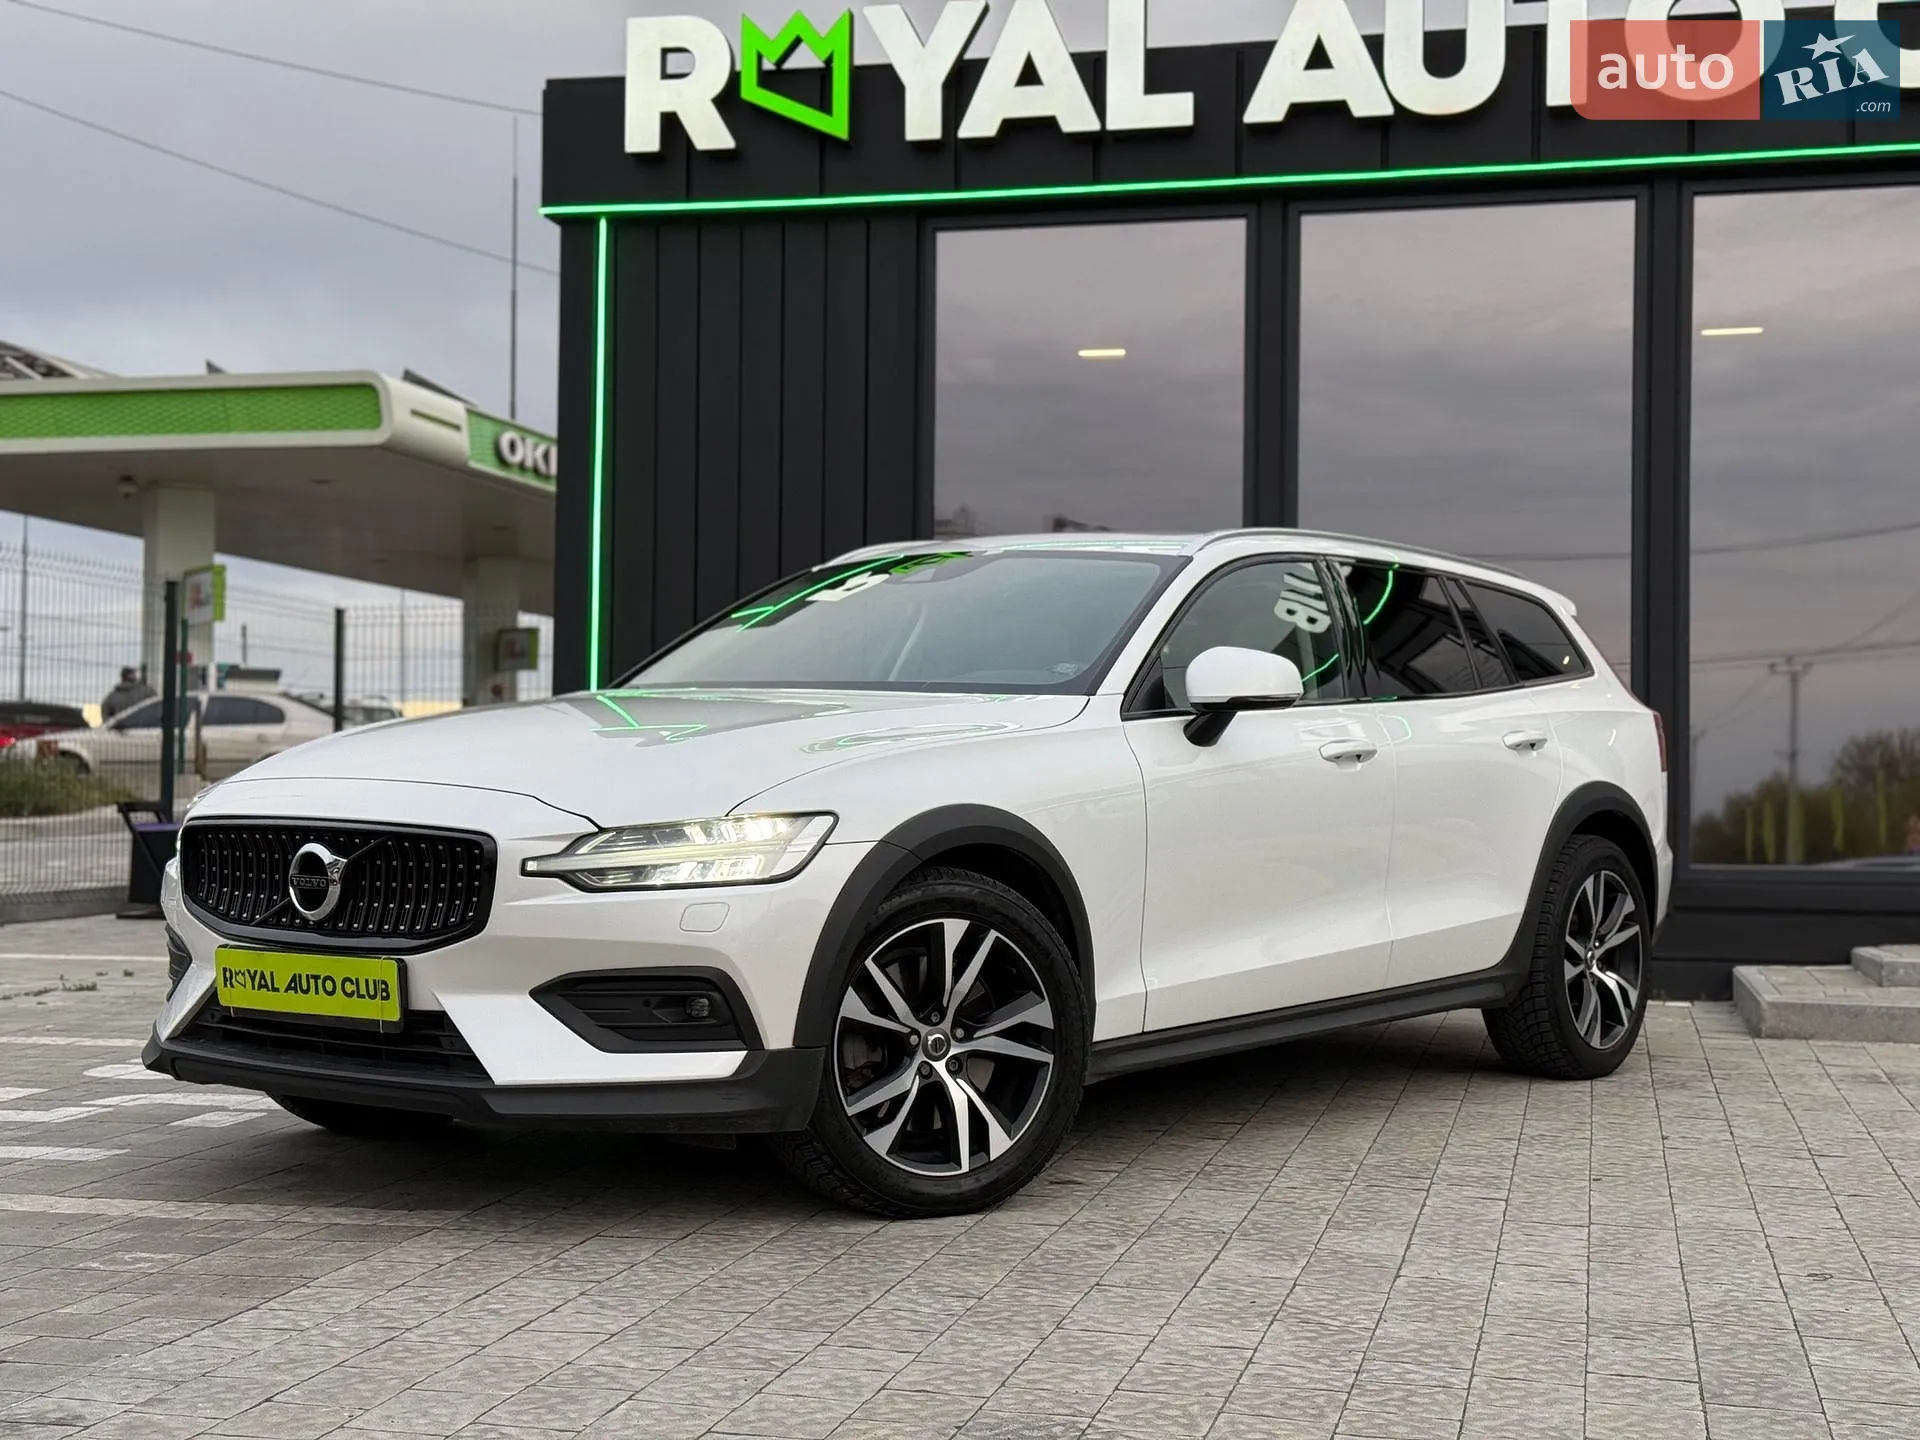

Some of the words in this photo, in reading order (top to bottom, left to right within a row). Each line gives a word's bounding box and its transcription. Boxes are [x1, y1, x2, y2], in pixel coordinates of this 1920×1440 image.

[291, 876, 327, 888] VOLVO
[284, 972, 337, 997] AUTO
[340, 976, 391, 1001] CLUB
